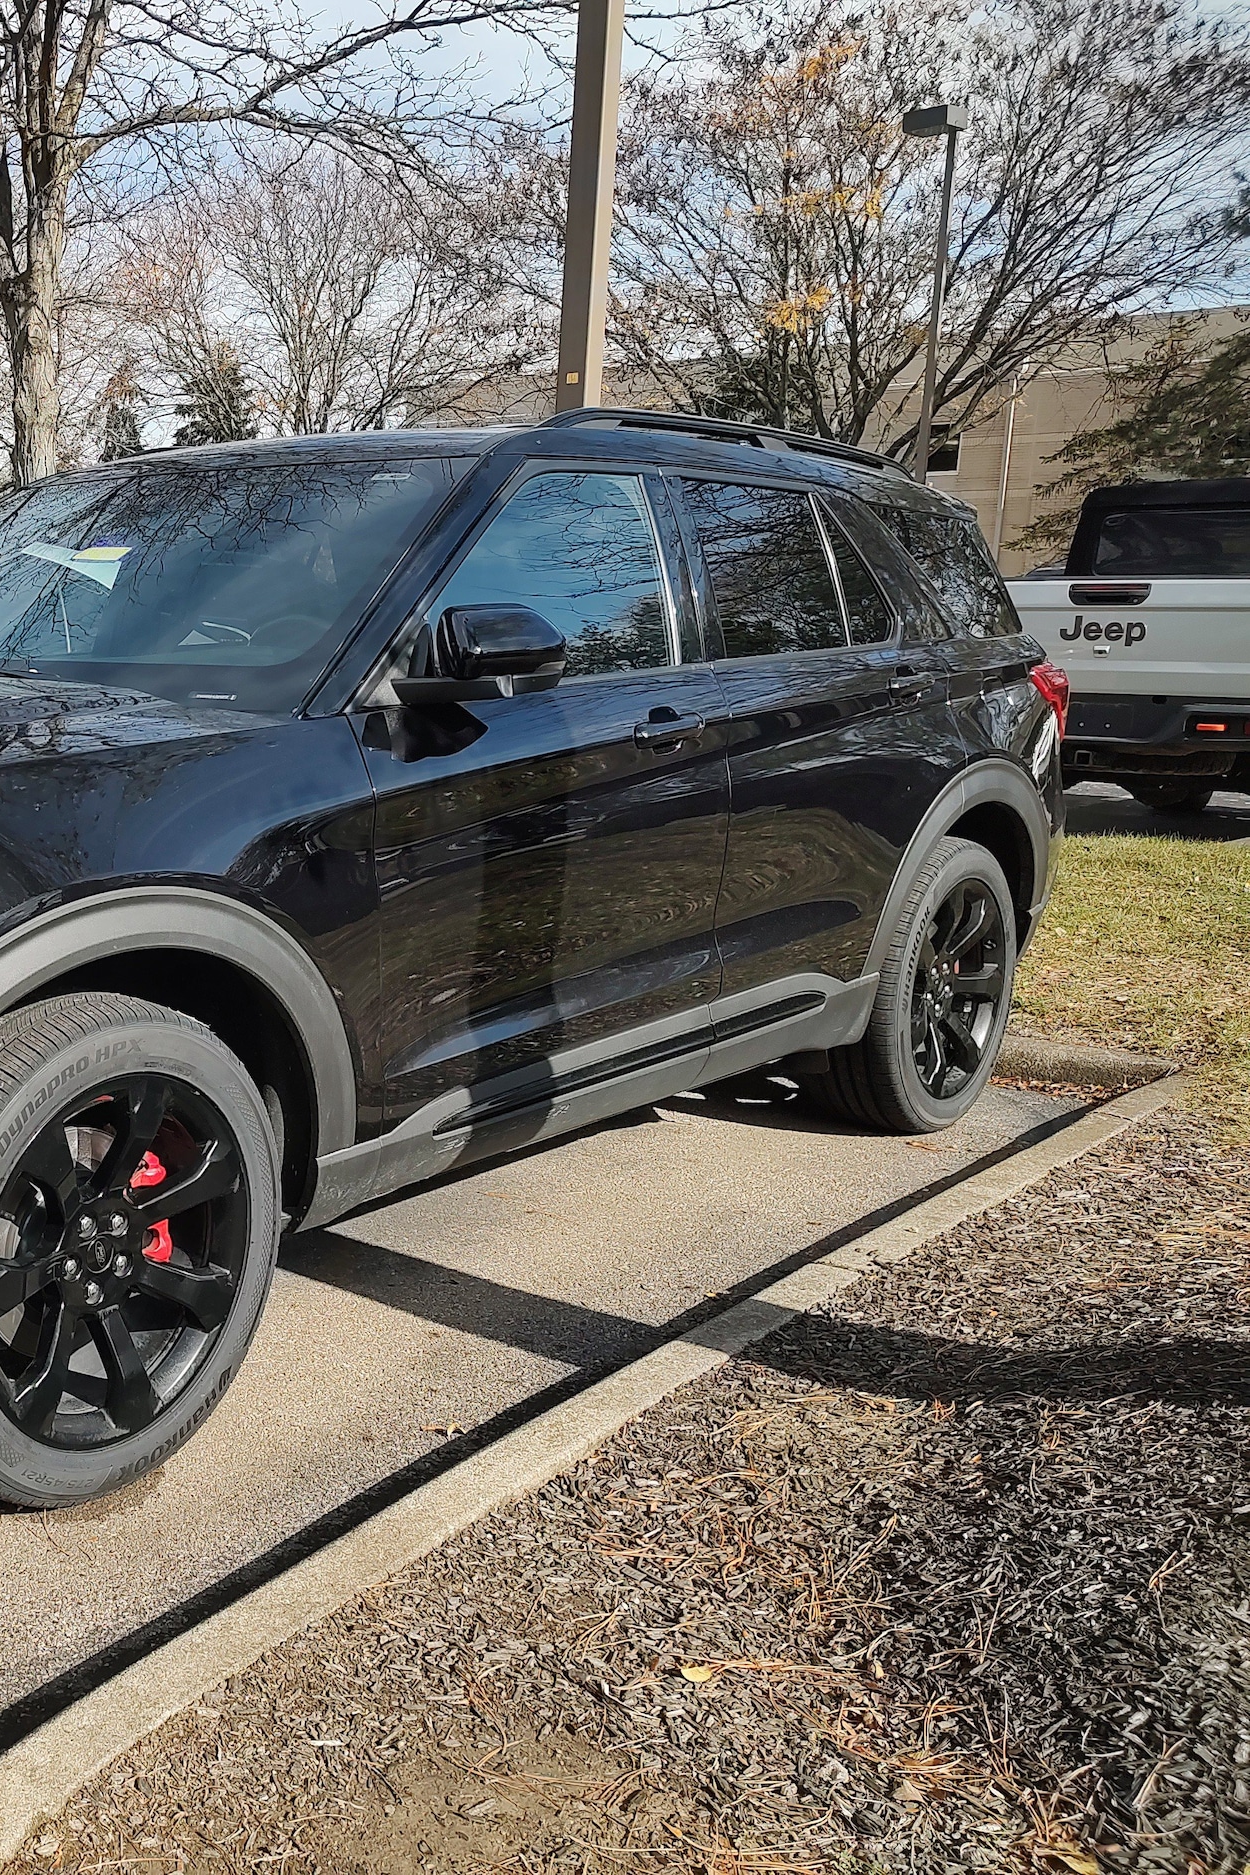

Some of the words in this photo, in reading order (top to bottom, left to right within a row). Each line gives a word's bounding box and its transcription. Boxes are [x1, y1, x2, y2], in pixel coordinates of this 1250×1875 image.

[1059, 615, 1147, 647] Jeep
[95, 1038, 143, 1064] HPX
[20, 1467, 96, 1489] 275/45R21
